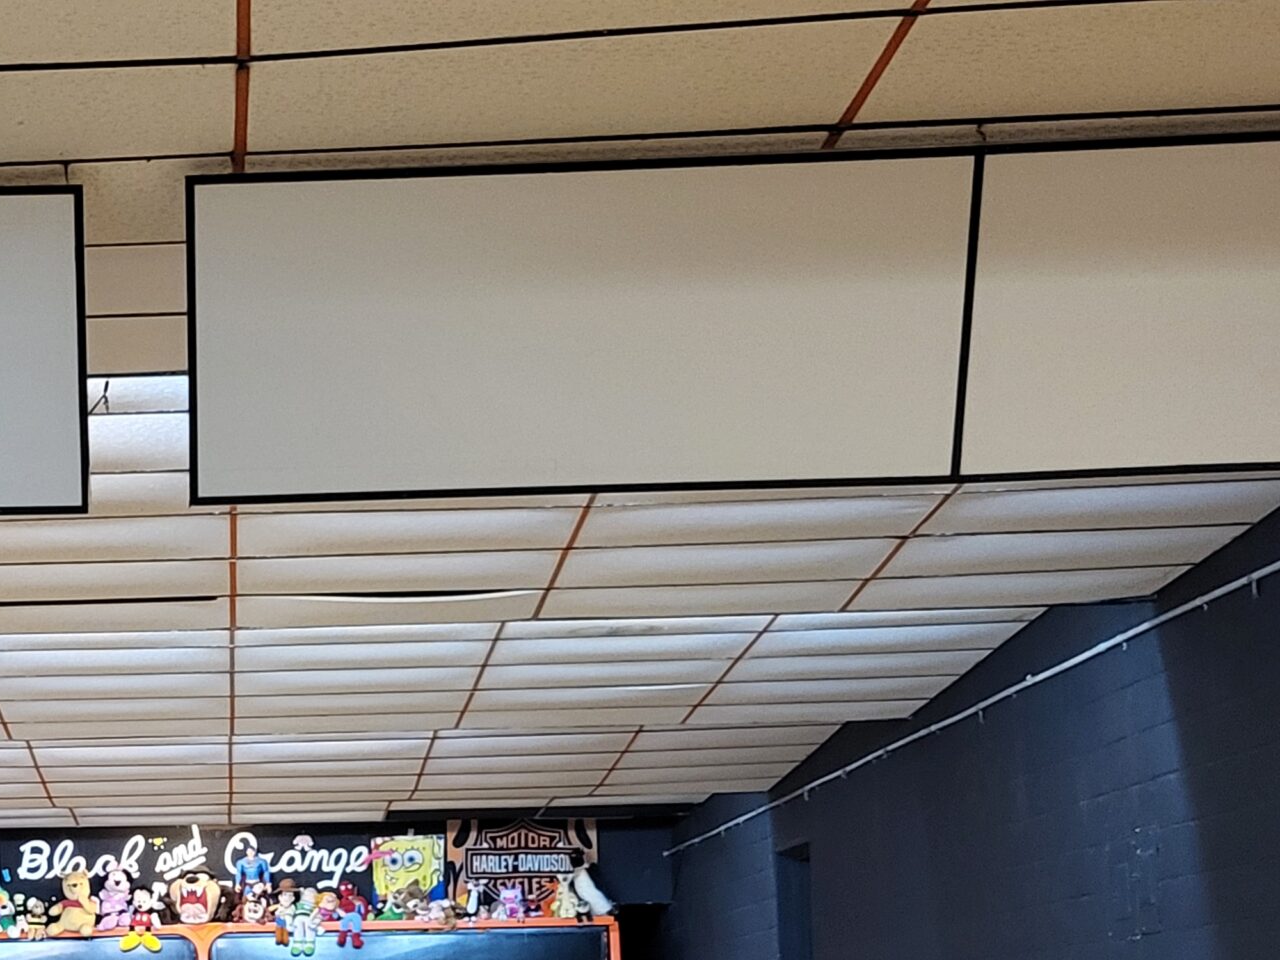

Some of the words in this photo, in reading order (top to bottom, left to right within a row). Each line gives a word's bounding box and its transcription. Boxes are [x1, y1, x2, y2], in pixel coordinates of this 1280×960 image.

[17, 834, 146, 880] Black
[154, 823, 209, 873] and
[496, 833, 551, 849] MOTOR
